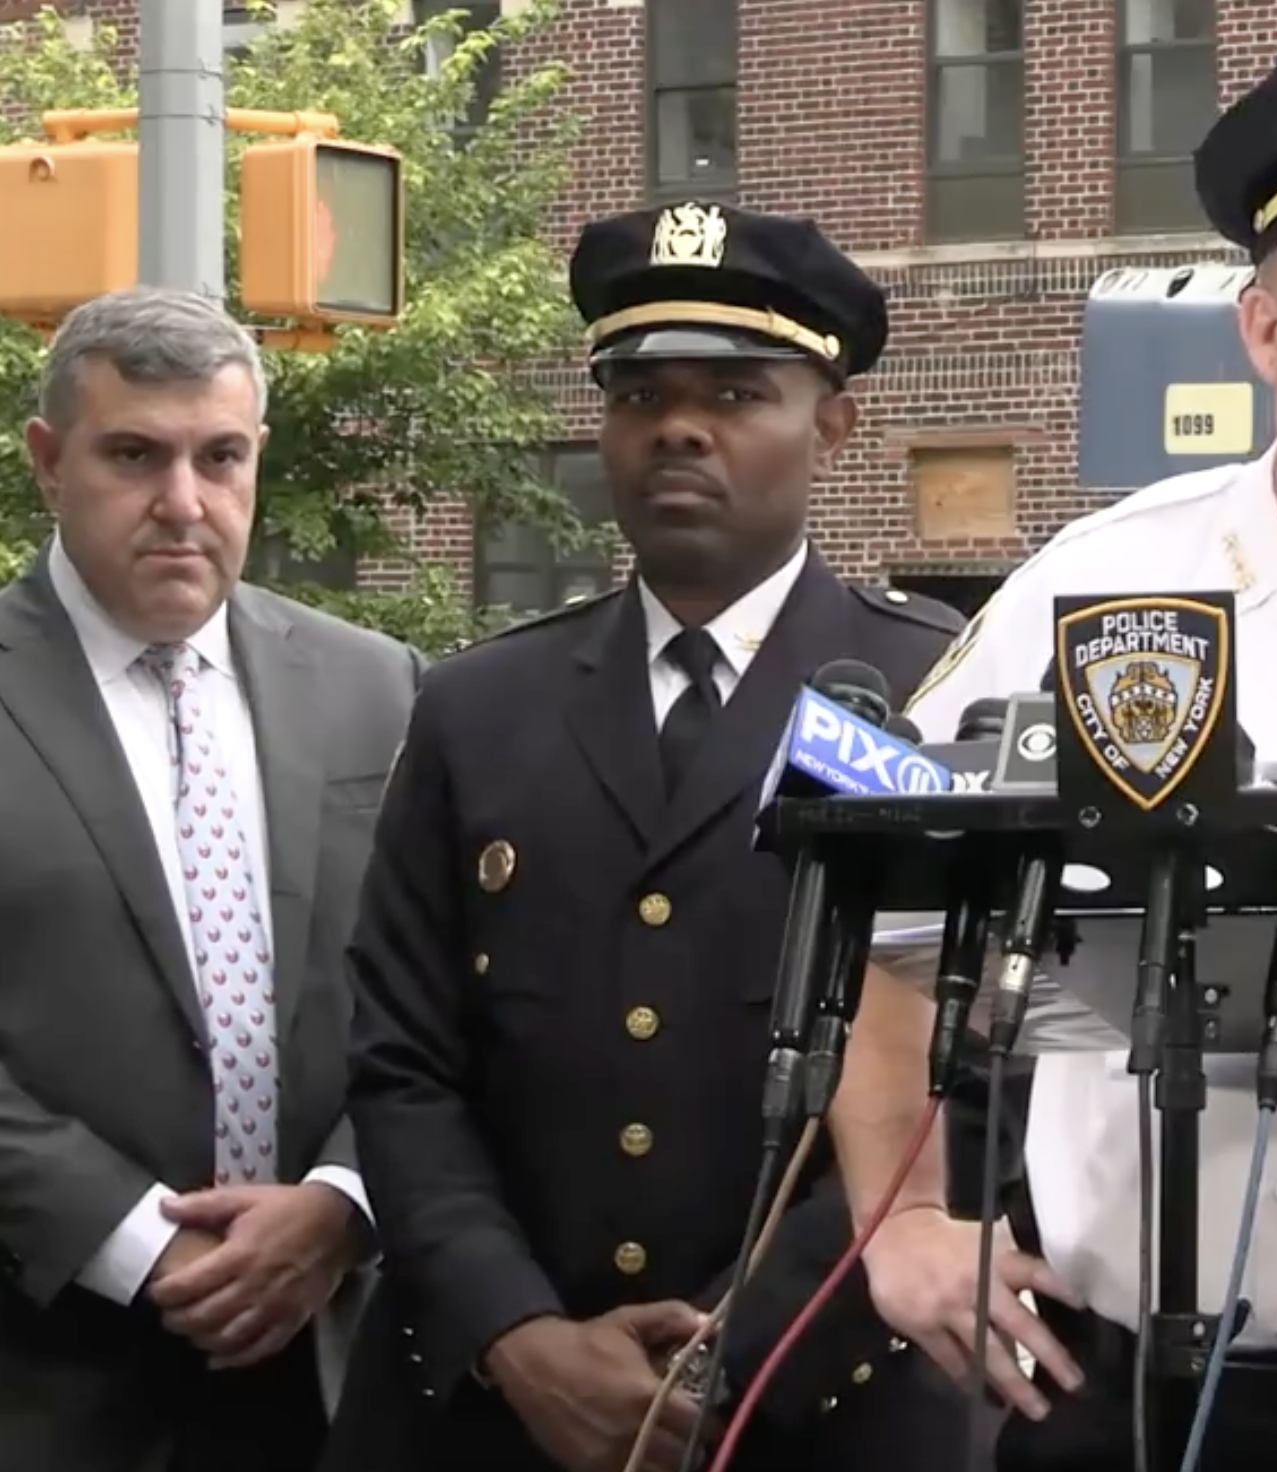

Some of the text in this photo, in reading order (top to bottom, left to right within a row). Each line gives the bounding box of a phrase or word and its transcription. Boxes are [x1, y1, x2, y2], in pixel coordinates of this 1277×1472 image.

[1172, 412, 1215, 437] 1099
[1102, 610, 1179, 636] POLICE
[1075, 631, 1210, 668] DEPARTMENT
[801, 699, 897, 791] PIX
[1076, 676, 1214, 781] CITY OF NEW YORK
